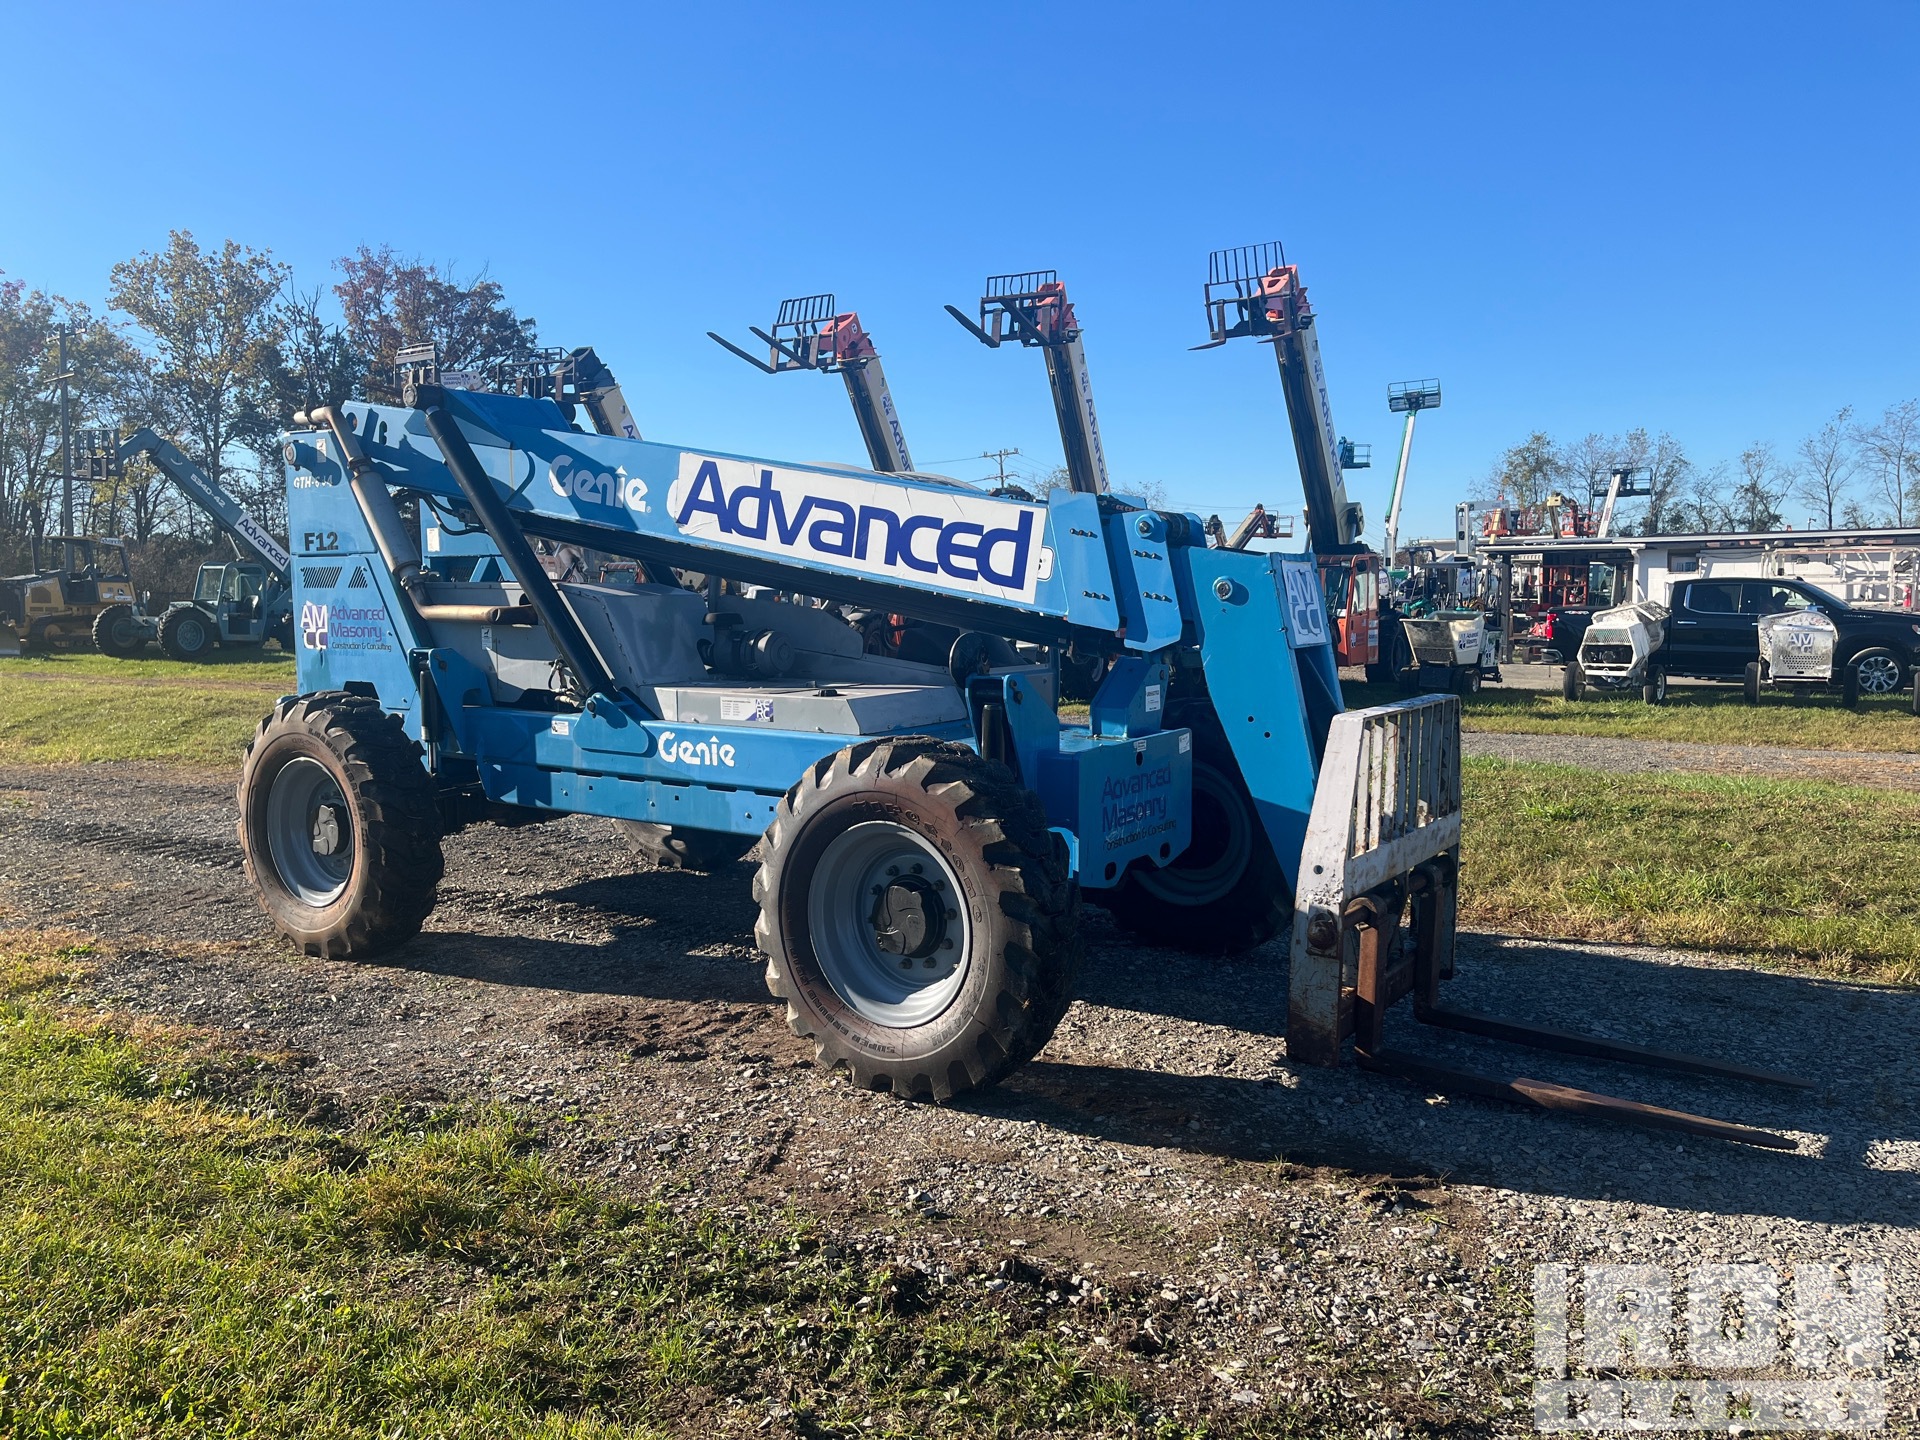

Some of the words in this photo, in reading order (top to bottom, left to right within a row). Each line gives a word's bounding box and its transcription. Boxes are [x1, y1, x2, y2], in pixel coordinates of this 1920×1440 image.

[1086, 399, 1108, 491] Advanced
[1319, 388, 1343, 487] Advanced
[549, 455, 648, 513] Genie
[238, 518, 289, 567] Advanced
[304, 532, 339, 551] F12
[676, 460, 1034, 590] Advanced
[330, 605, 385, 621] Advanced
[331, 623, 382, 642] Masonry
[658, 731, 736, 767] Genie
[1101, 761, 1171, 803] Advanced
[1102, 797, 1167, 833] Masonry
